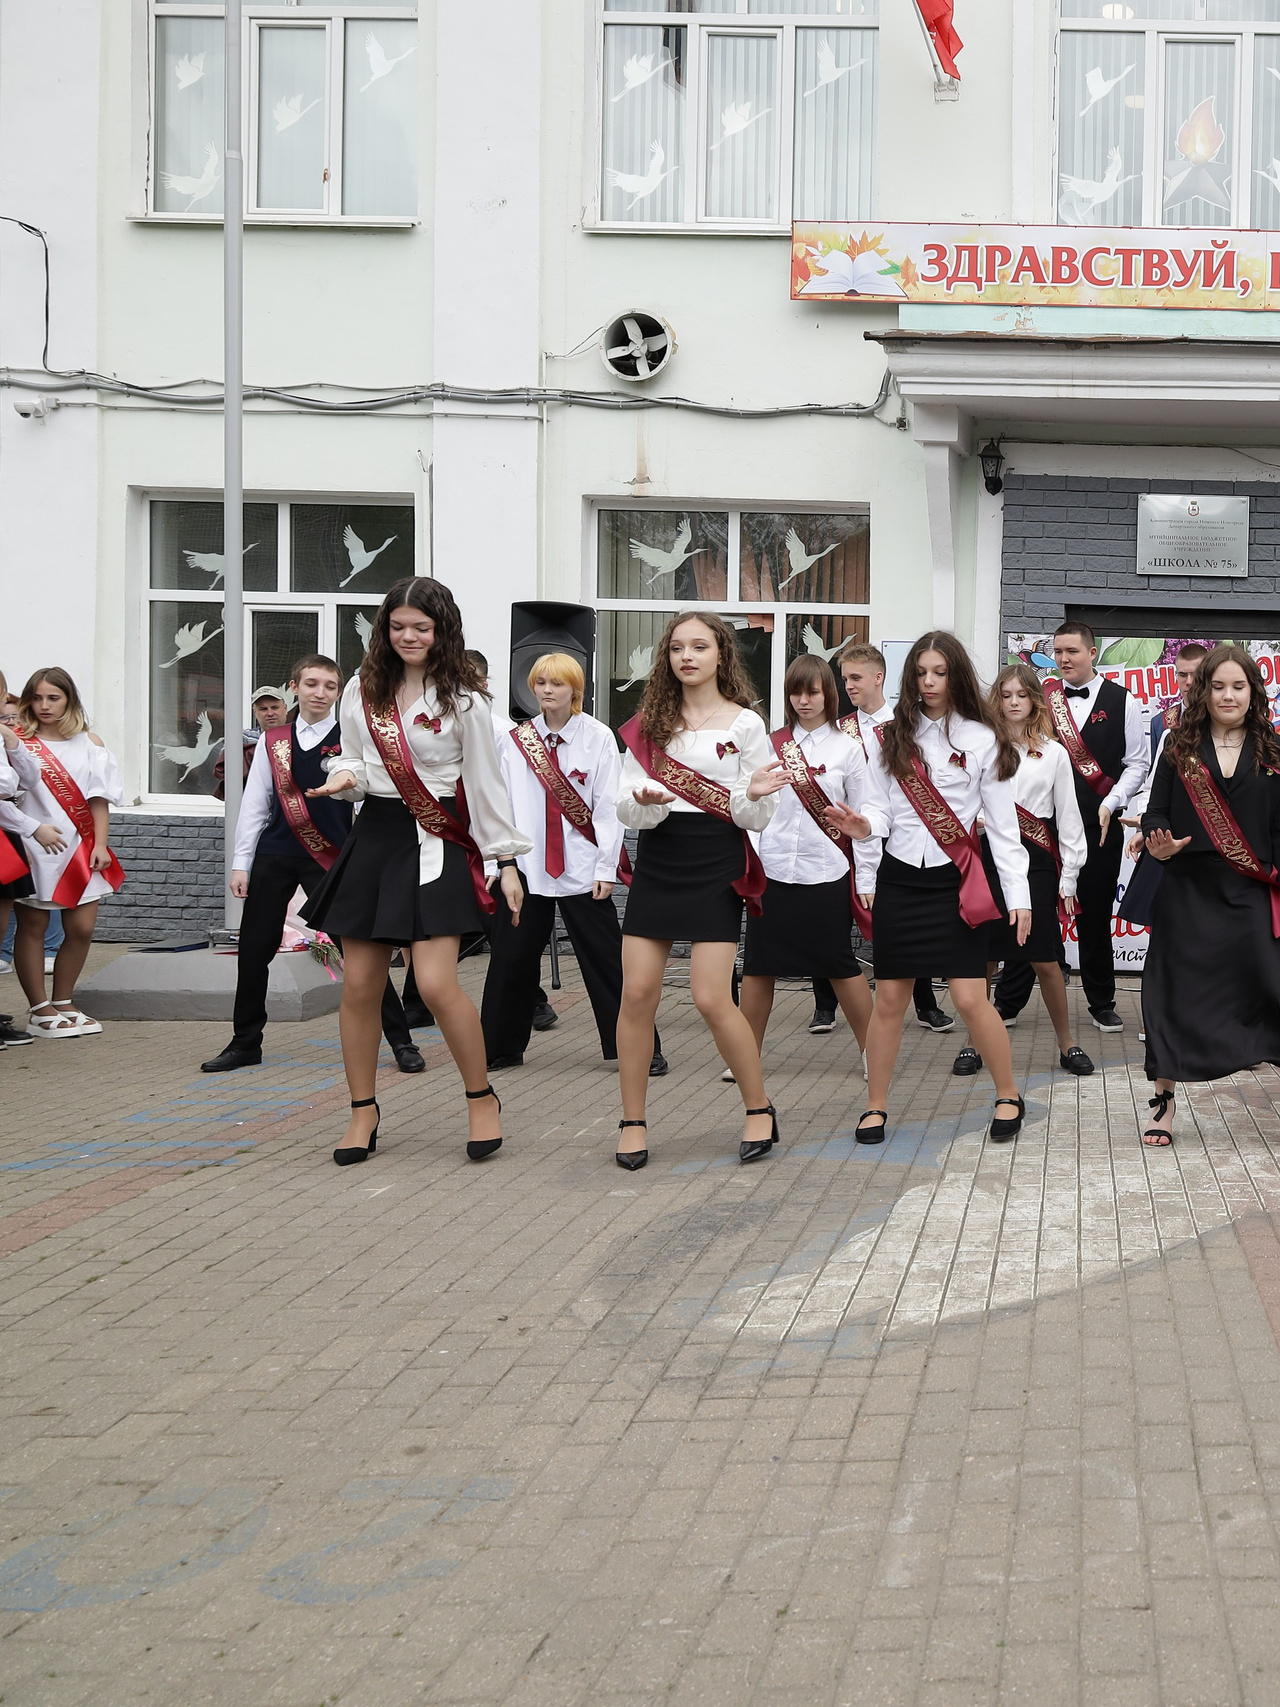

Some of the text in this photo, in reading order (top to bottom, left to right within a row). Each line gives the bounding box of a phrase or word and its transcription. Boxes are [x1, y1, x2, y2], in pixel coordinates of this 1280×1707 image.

[921, 239, 1250, 297] ЗДРАВСТВУЙ,
[1148, 558, 1237, 569] «ШКОЛА № 75»
[923, 805, 965, 845] 2025
